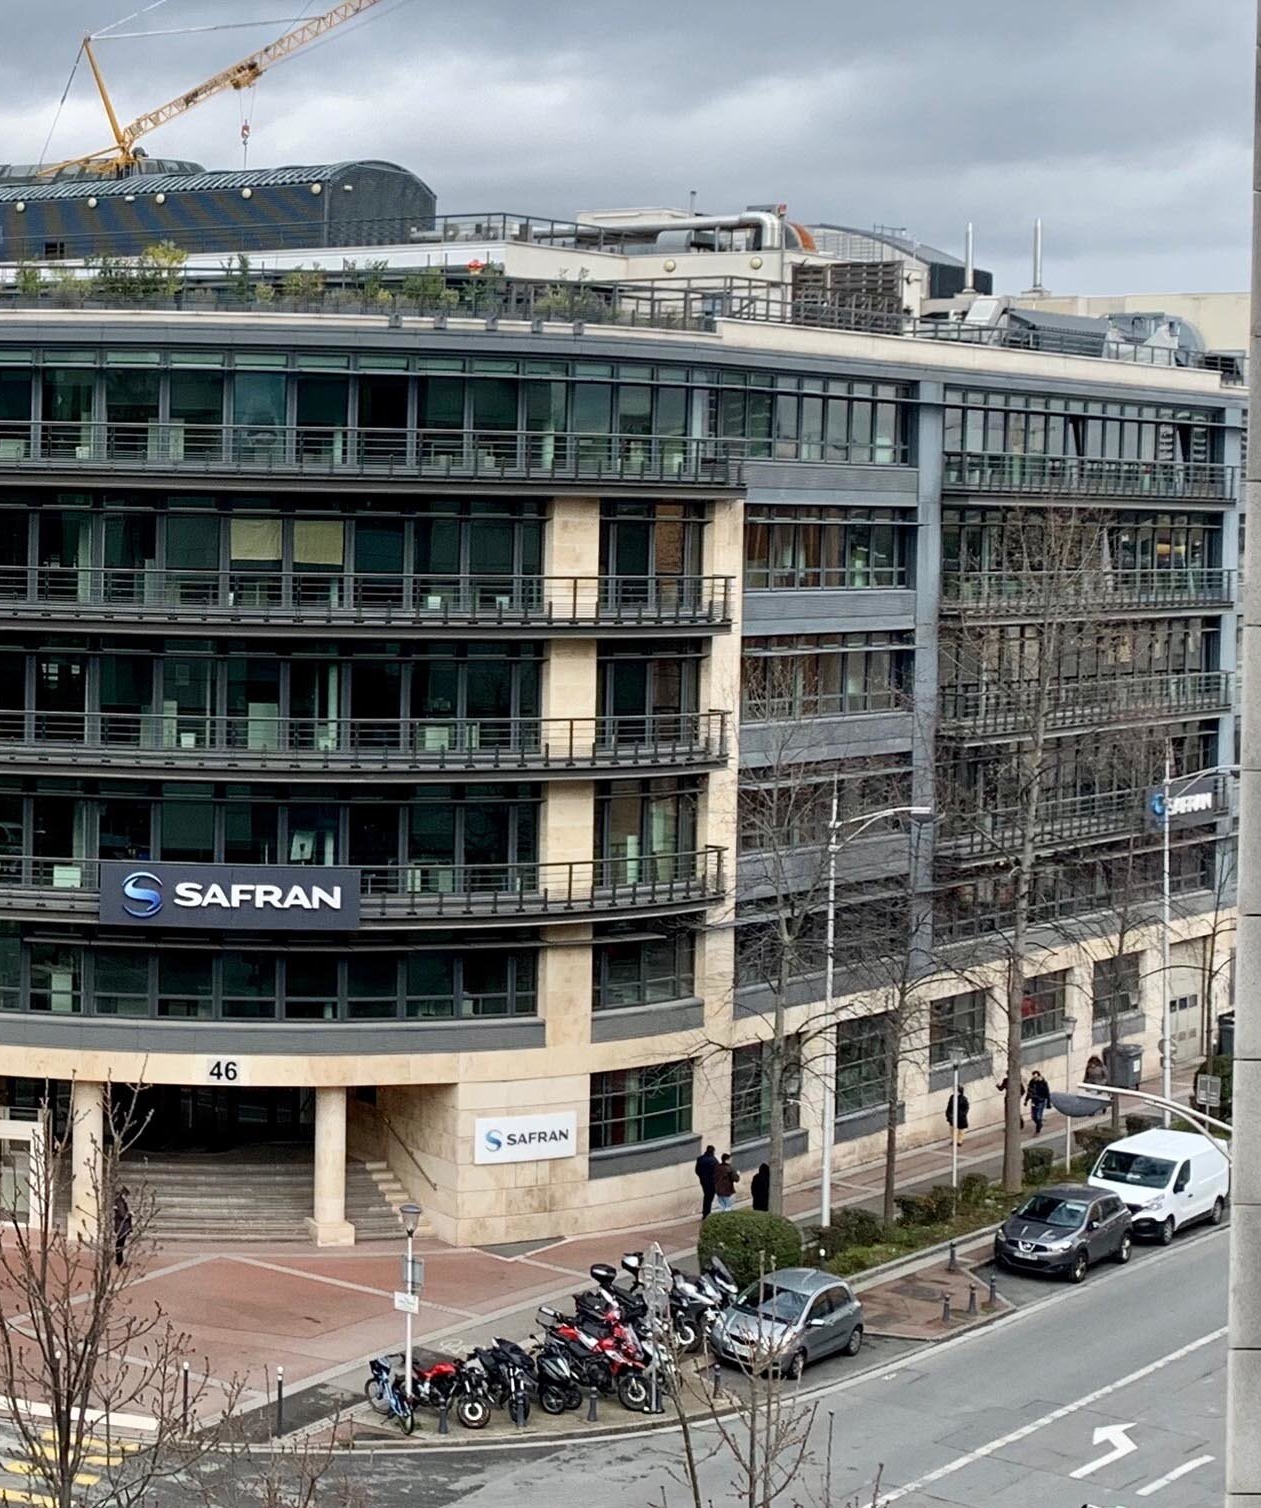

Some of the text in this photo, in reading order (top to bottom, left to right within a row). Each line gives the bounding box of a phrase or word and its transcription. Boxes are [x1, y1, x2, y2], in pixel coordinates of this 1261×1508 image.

[174, 882, 340, 909] SAFRAN
[209, 1061, 237, 1080] 46
[506, 1129, 569, 1146] SAFRAN
